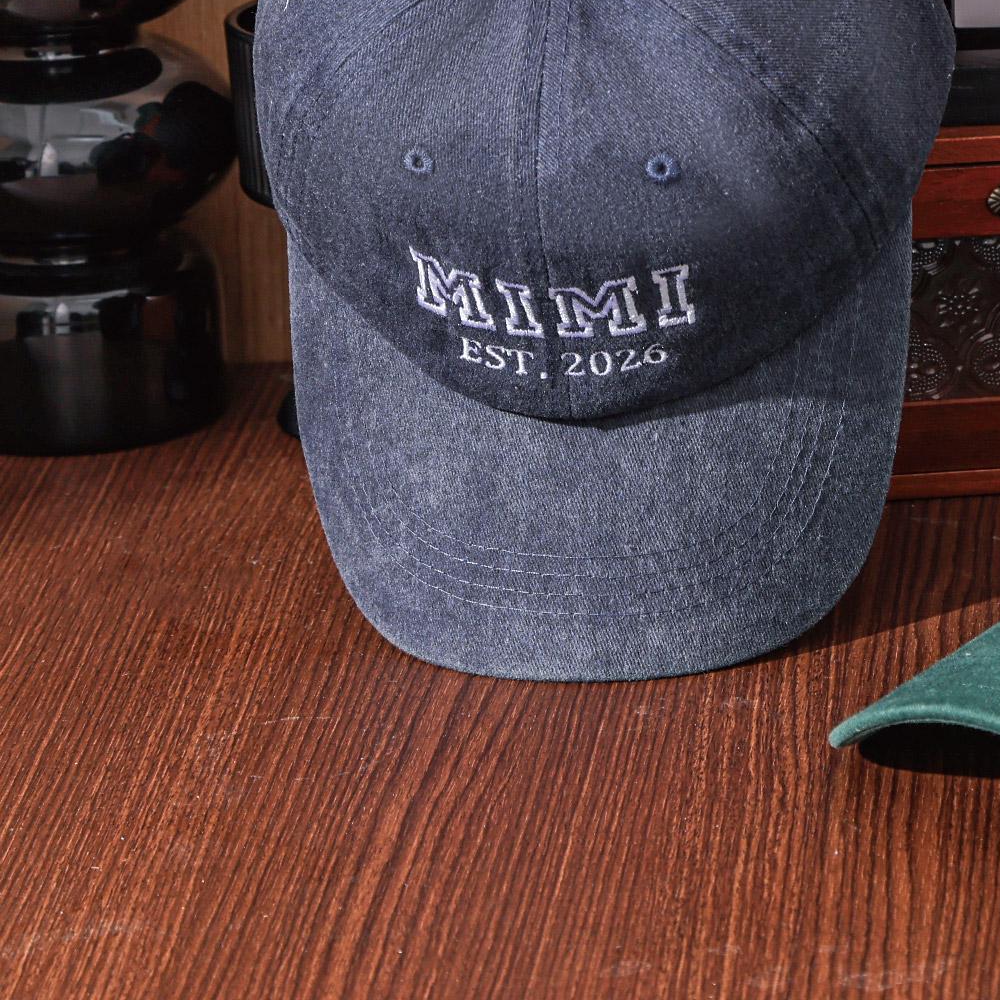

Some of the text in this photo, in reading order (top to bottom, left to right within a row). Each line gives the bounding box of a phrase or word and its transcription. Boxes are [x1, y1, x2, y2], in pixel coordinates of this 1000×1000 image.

[409, 246, 697, 339] MIMI
[460, 337, 668, 380] EST. 2026
